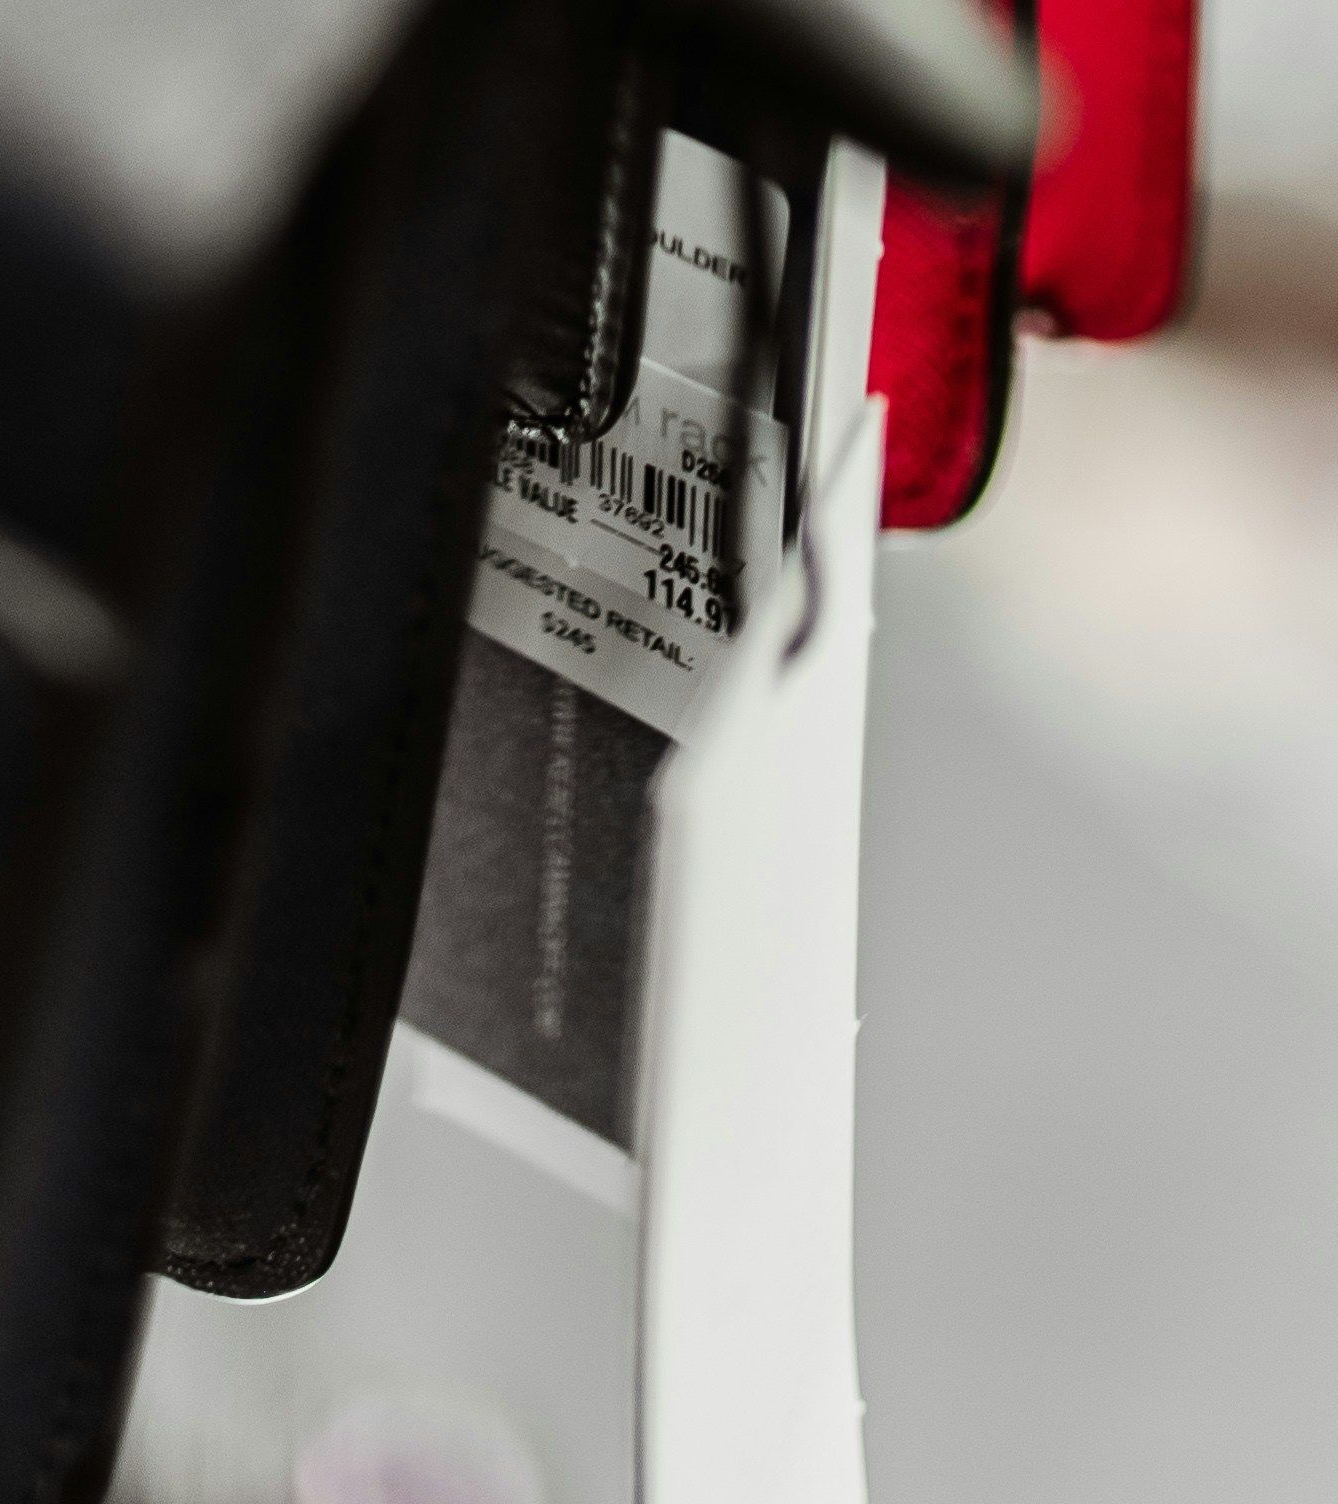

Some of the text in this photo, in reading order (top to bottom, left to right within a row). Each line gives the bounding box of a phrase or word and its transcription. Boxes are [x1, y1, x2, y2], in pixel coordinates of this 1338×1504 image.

[519, 474, 578, 524] VALUE
[541, 610, 596, 654] $245
[605, 609, 693, 671] RETAIL:
